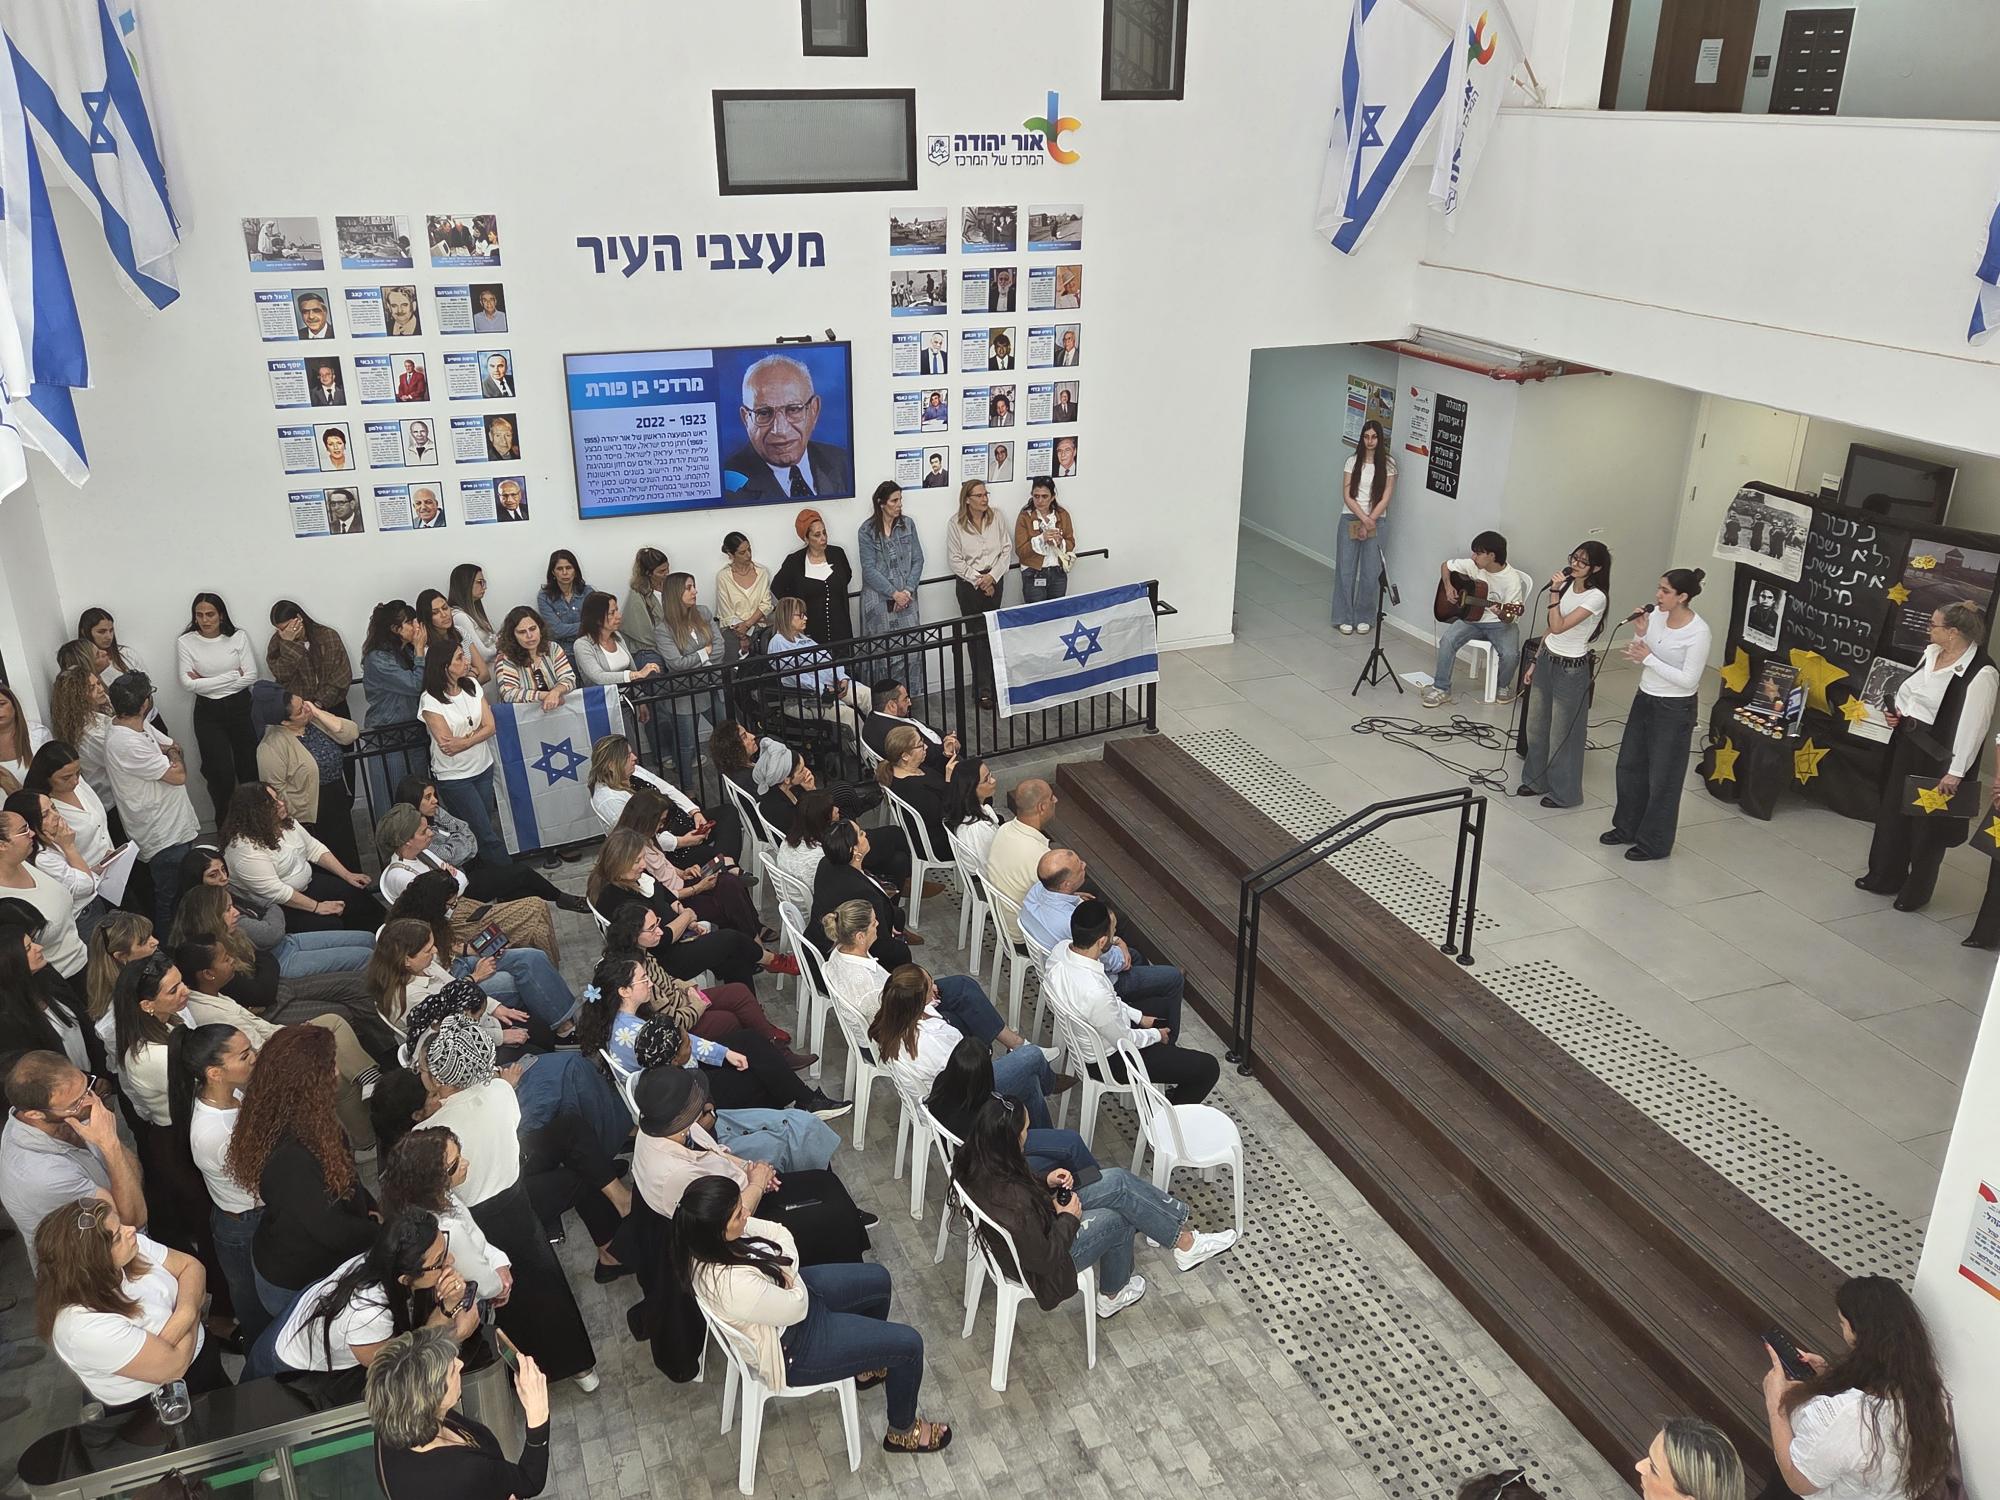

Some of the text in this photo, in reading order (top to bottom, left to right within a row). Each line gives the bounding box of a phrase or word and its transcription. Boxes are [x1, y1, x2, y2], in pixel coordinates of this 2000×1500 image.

[954, 134, 1045, 152] אור יהודה
[954, 152, 1044, 167] המרכז של המרכז
[576, 231, 826, 279] מעצבי העיר
[585, 377, 704, 398] מרדכי בן פורת
[636, 416, 665, 428] 2022
[680, 414, 707, 426] 1923
[631, 433, 642, 441] של
[643, 433, 666, 442] הראשון
[667, 431, 691, 439] המועצה
[692, 430, 707, 438] ראש
[584, 446, 602, 454] מבצע
[603, 444, 622, 452] בראש
[623, 468, 645, 476] בשנים
[685, 464, 709, 472] שהוביל
[587, 470, 620, 479] הראשונות
[601, 479, 617, 488] כסגן
[639, 476, 660, 484] השנים
[690, 481, 711, 489] הכנסת
[696, 489, 712, 497] העיר
[1808, 531, 1841, 558] נשכח
[1805, 556, 1844, 577] ששת
[1840, 570, 1887, 588] את
